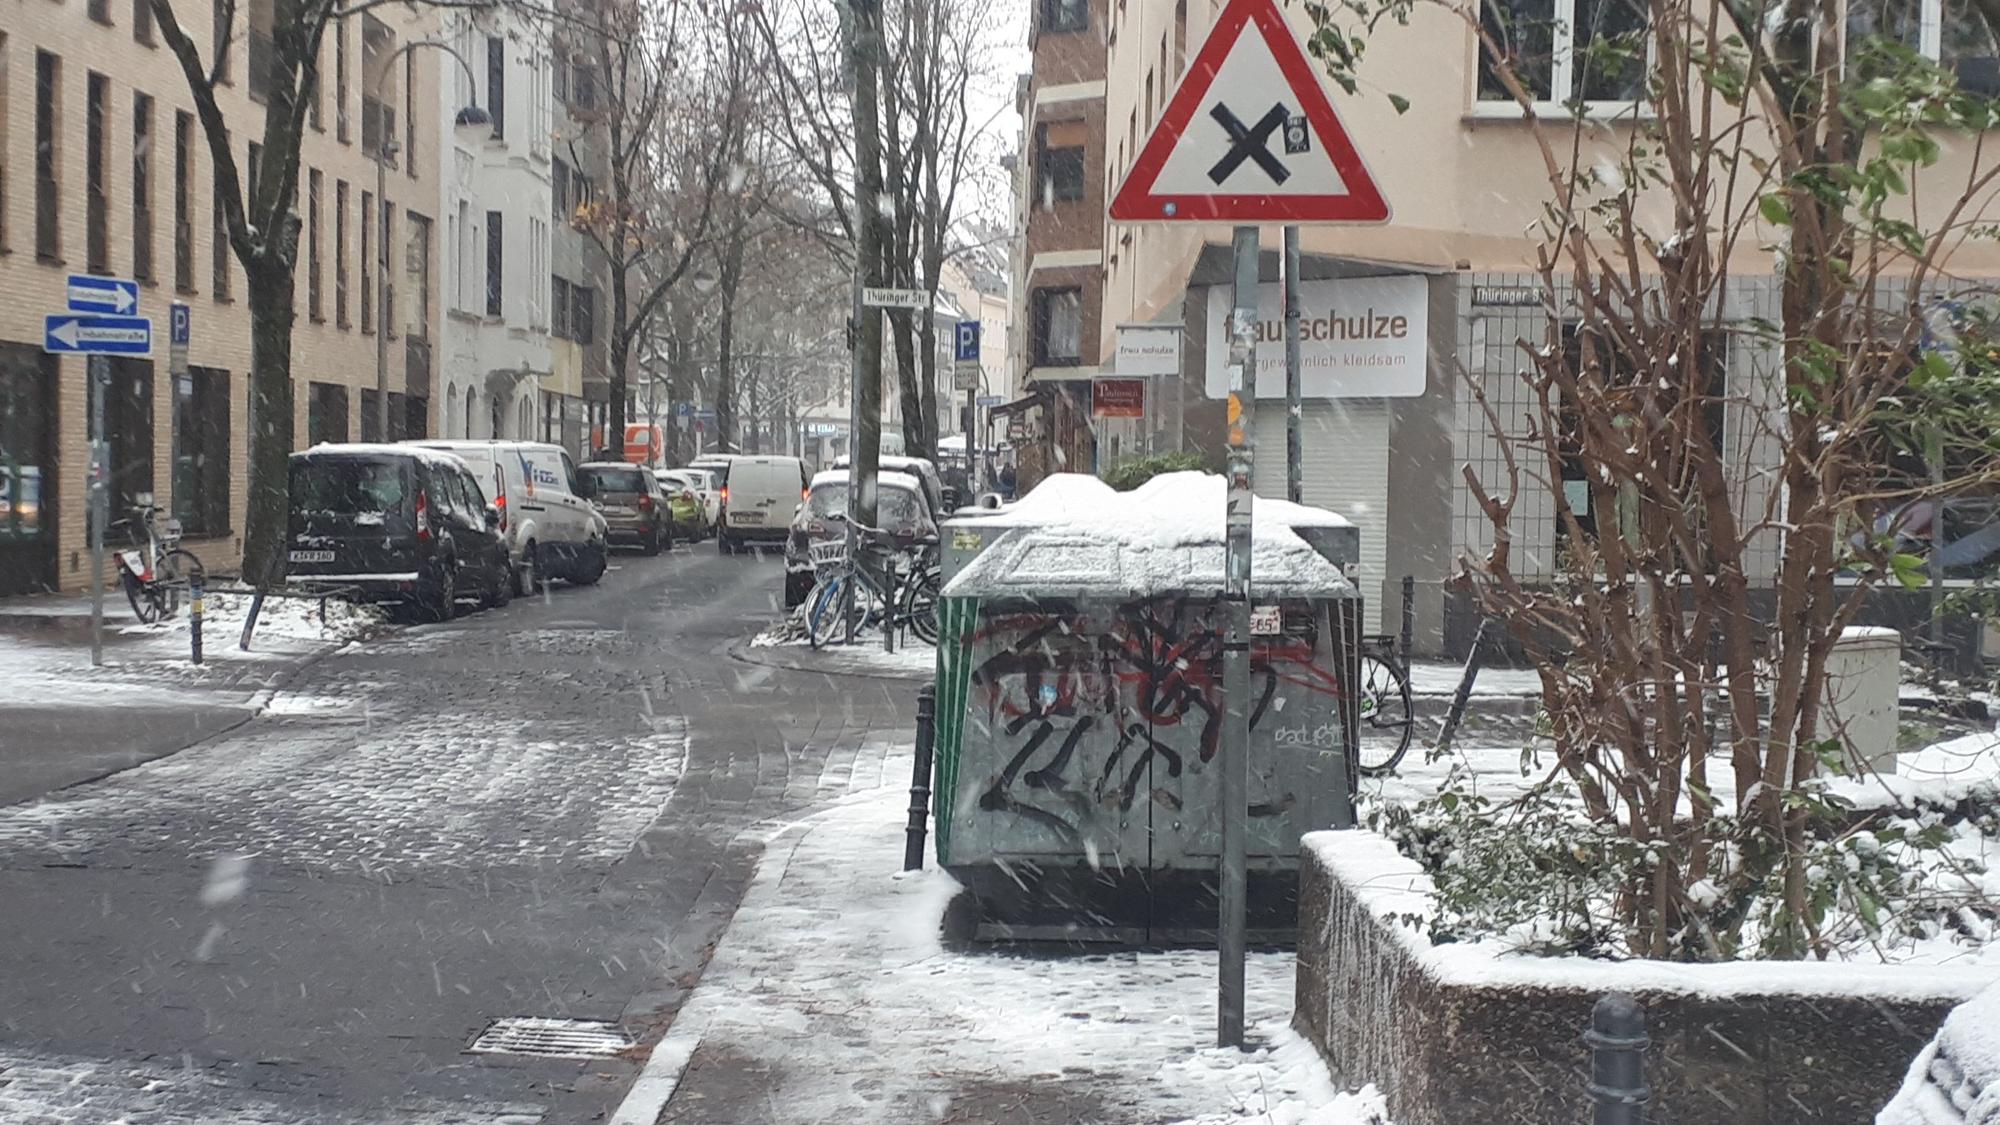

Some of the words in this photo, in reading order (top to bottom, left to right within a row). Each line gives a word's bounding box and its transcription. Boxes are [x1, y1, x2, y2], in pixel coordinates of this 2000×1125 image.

[866, 289, 908, 305] Thüringer
[1476, 287, 1528, 305] Thüringer
[175, 309, 187, 341] P
[1224, 313, 1283, 344] fau
[1299, 307, 1408, 341] schulze
[960, 326, 974, 358] P
[1343, 353, 1406, 367] kleidsam
